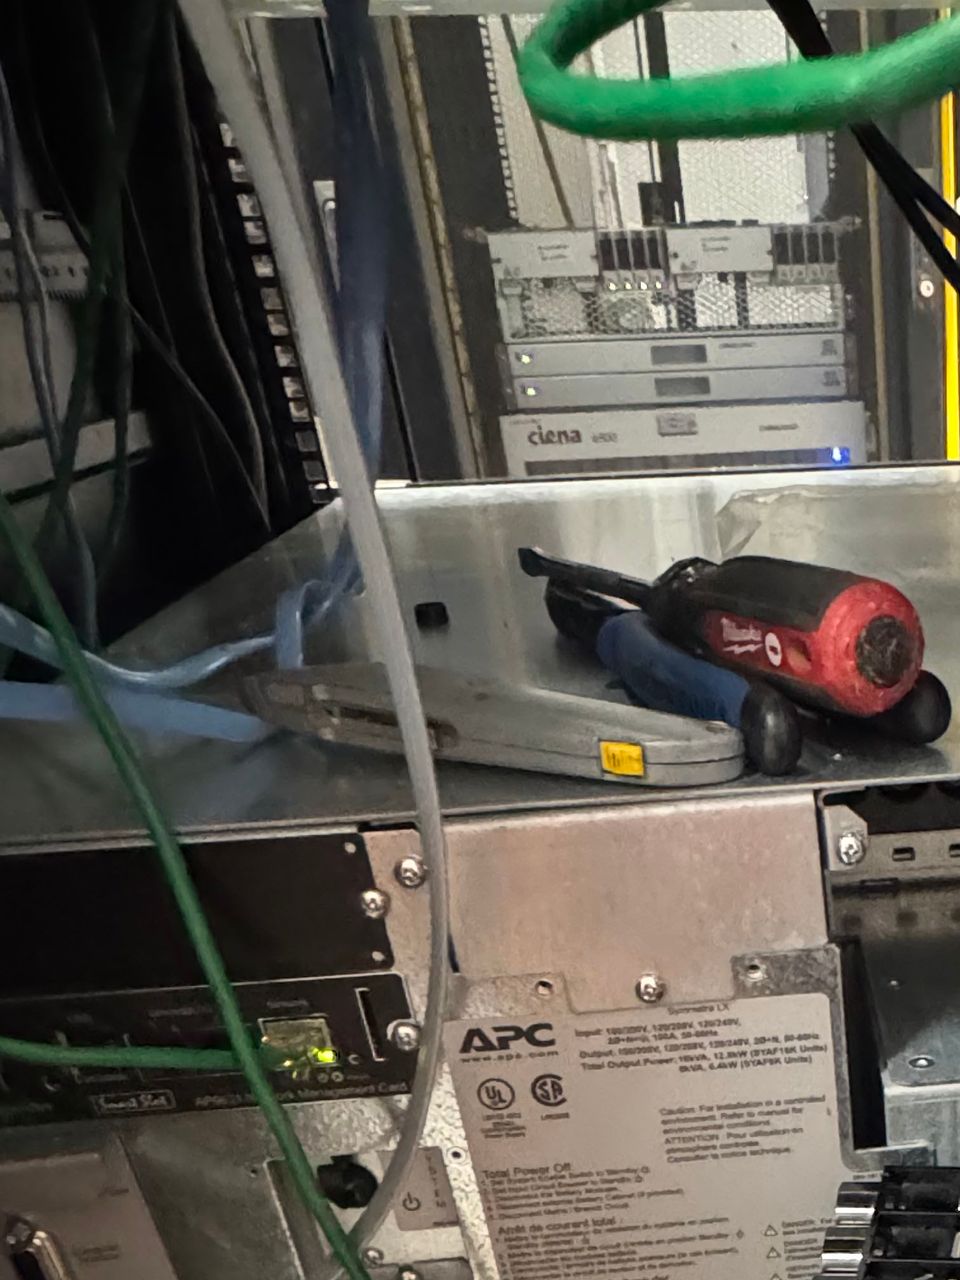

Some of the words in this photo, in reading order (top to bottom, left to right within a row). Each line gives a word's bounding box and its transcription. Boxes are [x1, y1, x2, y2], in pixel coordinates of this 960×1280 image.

[527, 425, 582, 445] ciena
[459, 1023, 556, 1054] APC
[482, 1168, 510, 1180] Total
[513, 1166, 550, 1176] Power
